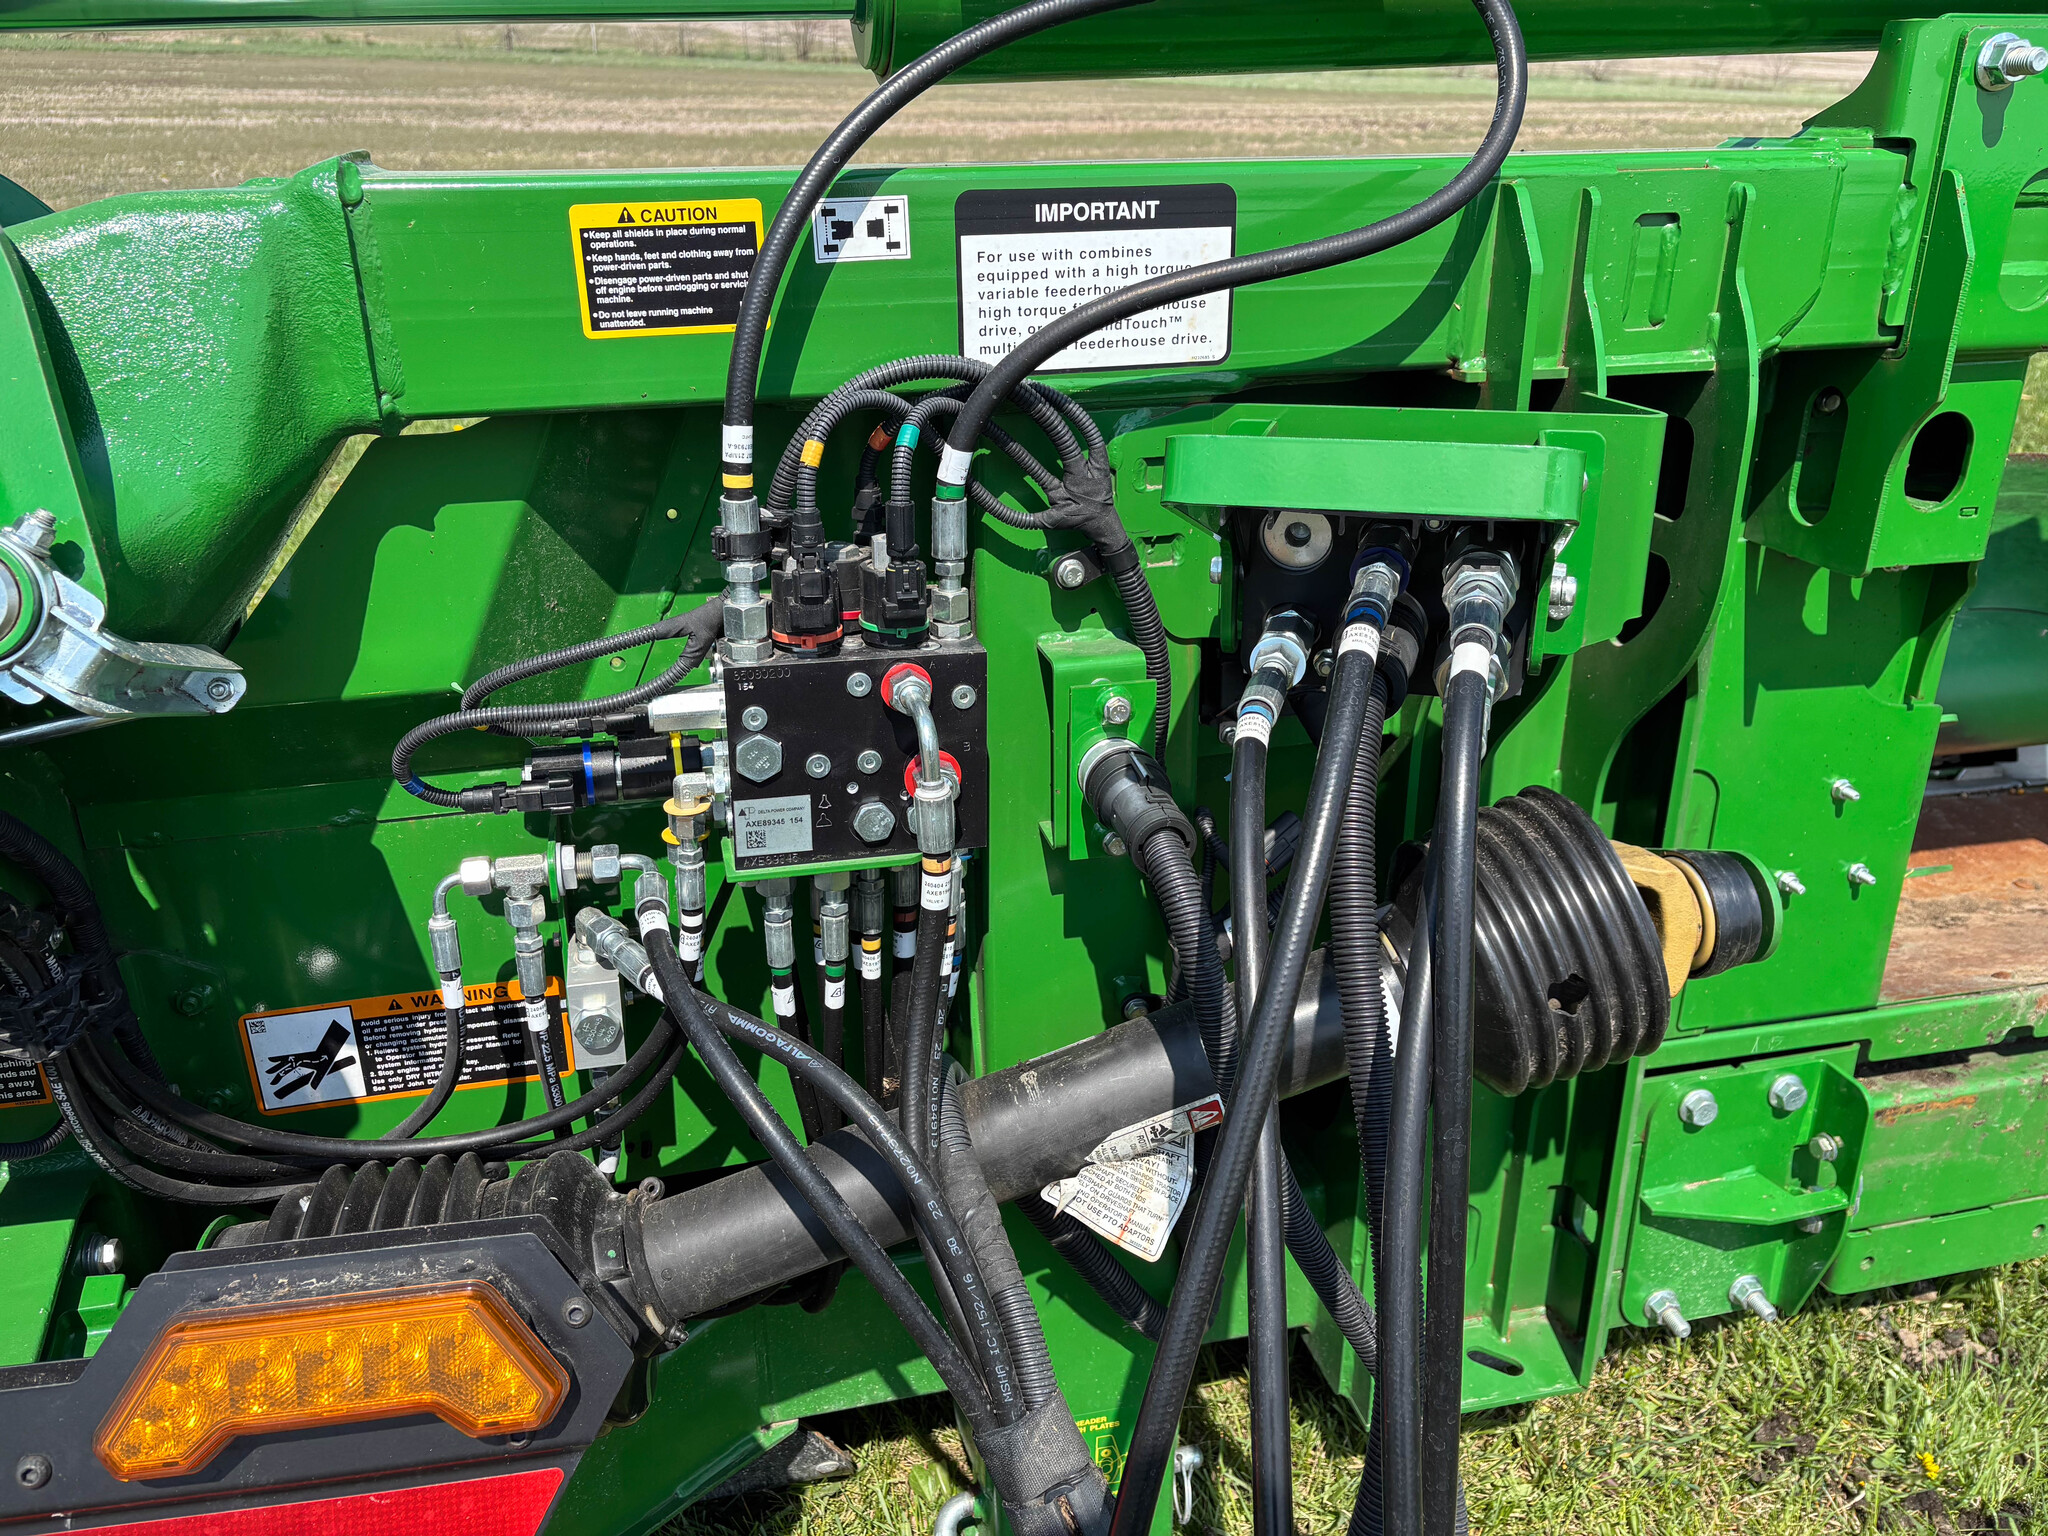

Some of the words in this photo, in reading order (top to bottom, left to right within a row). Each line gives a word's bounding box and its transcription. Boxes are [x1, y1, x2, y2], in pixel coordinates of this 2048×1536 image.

[641, 207, 717, 222] CAUTION
[1035, 200, 1160, 223] IMPORTANT
[589, 231, 610, 239] Keep
[612, 230, 622, 238] all
[624, 229, 654, 238] shields
[656, 228, 664, 236] in
[666, 228, 687, 238] place
[689, 227, 716, 236] during
[718, 225, 746, 234] normal
[590, 239, 636, 250] operations.
[592, 254, 613, 263] Keep
[614, 253, 642, 262] hands,
[644, 252, 660, 260] feet
[661, 251, 677, 259] and
[679, 250, 711, 259] clothing
[714, 250, 733, 258] away
[735, 248, 754, 256] from
[977, 252, 1002, 263] For
[1009, 251, 1035, 262] use
[1042, 249, 1073, 261] with
[1080, 246, 1152, 259] combines
[593, 262, 646, 272] power-driven
[648, 261, 672, 270] parts.
[977, 264, 1048, 283] equipped
[1055, 267, 1086, 279] with
[1092, 269, 1100, 277] a
[1106, 265, 1138, 280] high
[595, 276, 637, 286] Disengage
[639, 273, 691, 283] power-driven
[692, 273, 712, 282] parts
[714, 272, 729, 280] and
[596, 287, 607, 295] off
[608, 286, 636, 296] engine
[665, 282, 709, 293] unclogging
[978, 287, 1038, 300] variable
[597, 296, 633, 304] machine.
[599, 311, 609, 319] Do
[648, 308, 679, 317] running
[680, 307, 713, 315] machine
[978, 306, 1011, 320] high
[1018, 305, 1066, 318] torque
[600, 319, 646, 328] unattended.
[979, 324, 1022, 337] drive,
[1074, 334, 1165, 350] feederhouse
[1172, 333, 1212, 345] drive.
[746, 819, 785, 828] AXE89345
[411, 985, 508, 1008] WANING
[498, 1002, 526, 1010] hydrauli
[390, 1030, 420, 1038] removing
[728, 1012, 812, 1060] ALFAGOMMA
[376, 1040, 407, 1048] changing
[934, 1043, 941, 1060] 23
[386, 1053, 415, 1061] Operator
[404, 1057, 444, 1065] information.
[475, 1062, 510, 1072] recharging
[546, 1063, 556, 1083] MPa
[8, 1080, 35, 1088] away
[51, 1080, 66, 1101] SAE
[62, 1098, 83, 1133] exceeds
[138, 1108, 189, 1148] ALFAGOMMA
[1116, 1176, 1144, 1194] SECURELY
[1130, 1174, 1154, 1190] SHIELDS
[1161, 1190, 1179, 1204] PLACE
[1156, 1181, 1181, 1197] TRACTOR
[1090, 1187, 1099, 1195] ON
[1100, 1192, 1135, 1215] DRIVESHAFT
[1107, 1188, 1132, 1206] GUARDS
[1133, 1202, 1147, 1213] THAT
[1114, 1184, 1131, 1195] BOTH
[1131, 1193, 1146, 1204] ENDS
[1090, 1194, 1128, 1221] OPERATOR'S
[1128, 1218, 1152, 1234] MANUAL
[1087, 1204, 1103, 1216] USE
[1102, 1213, 1118, 1226] PTO
[1118, 1223, 1155, 1246] ADAPTORS
[927, 1200, 943, 1220] 23
[946, 1237, 963, 1256] 3Q
[963, 1272, 1000, 1356] IC-152/16
[995, 1364, 1013, 1402] MSHA
[1090, 1421, 1120, 1431] PLATES
